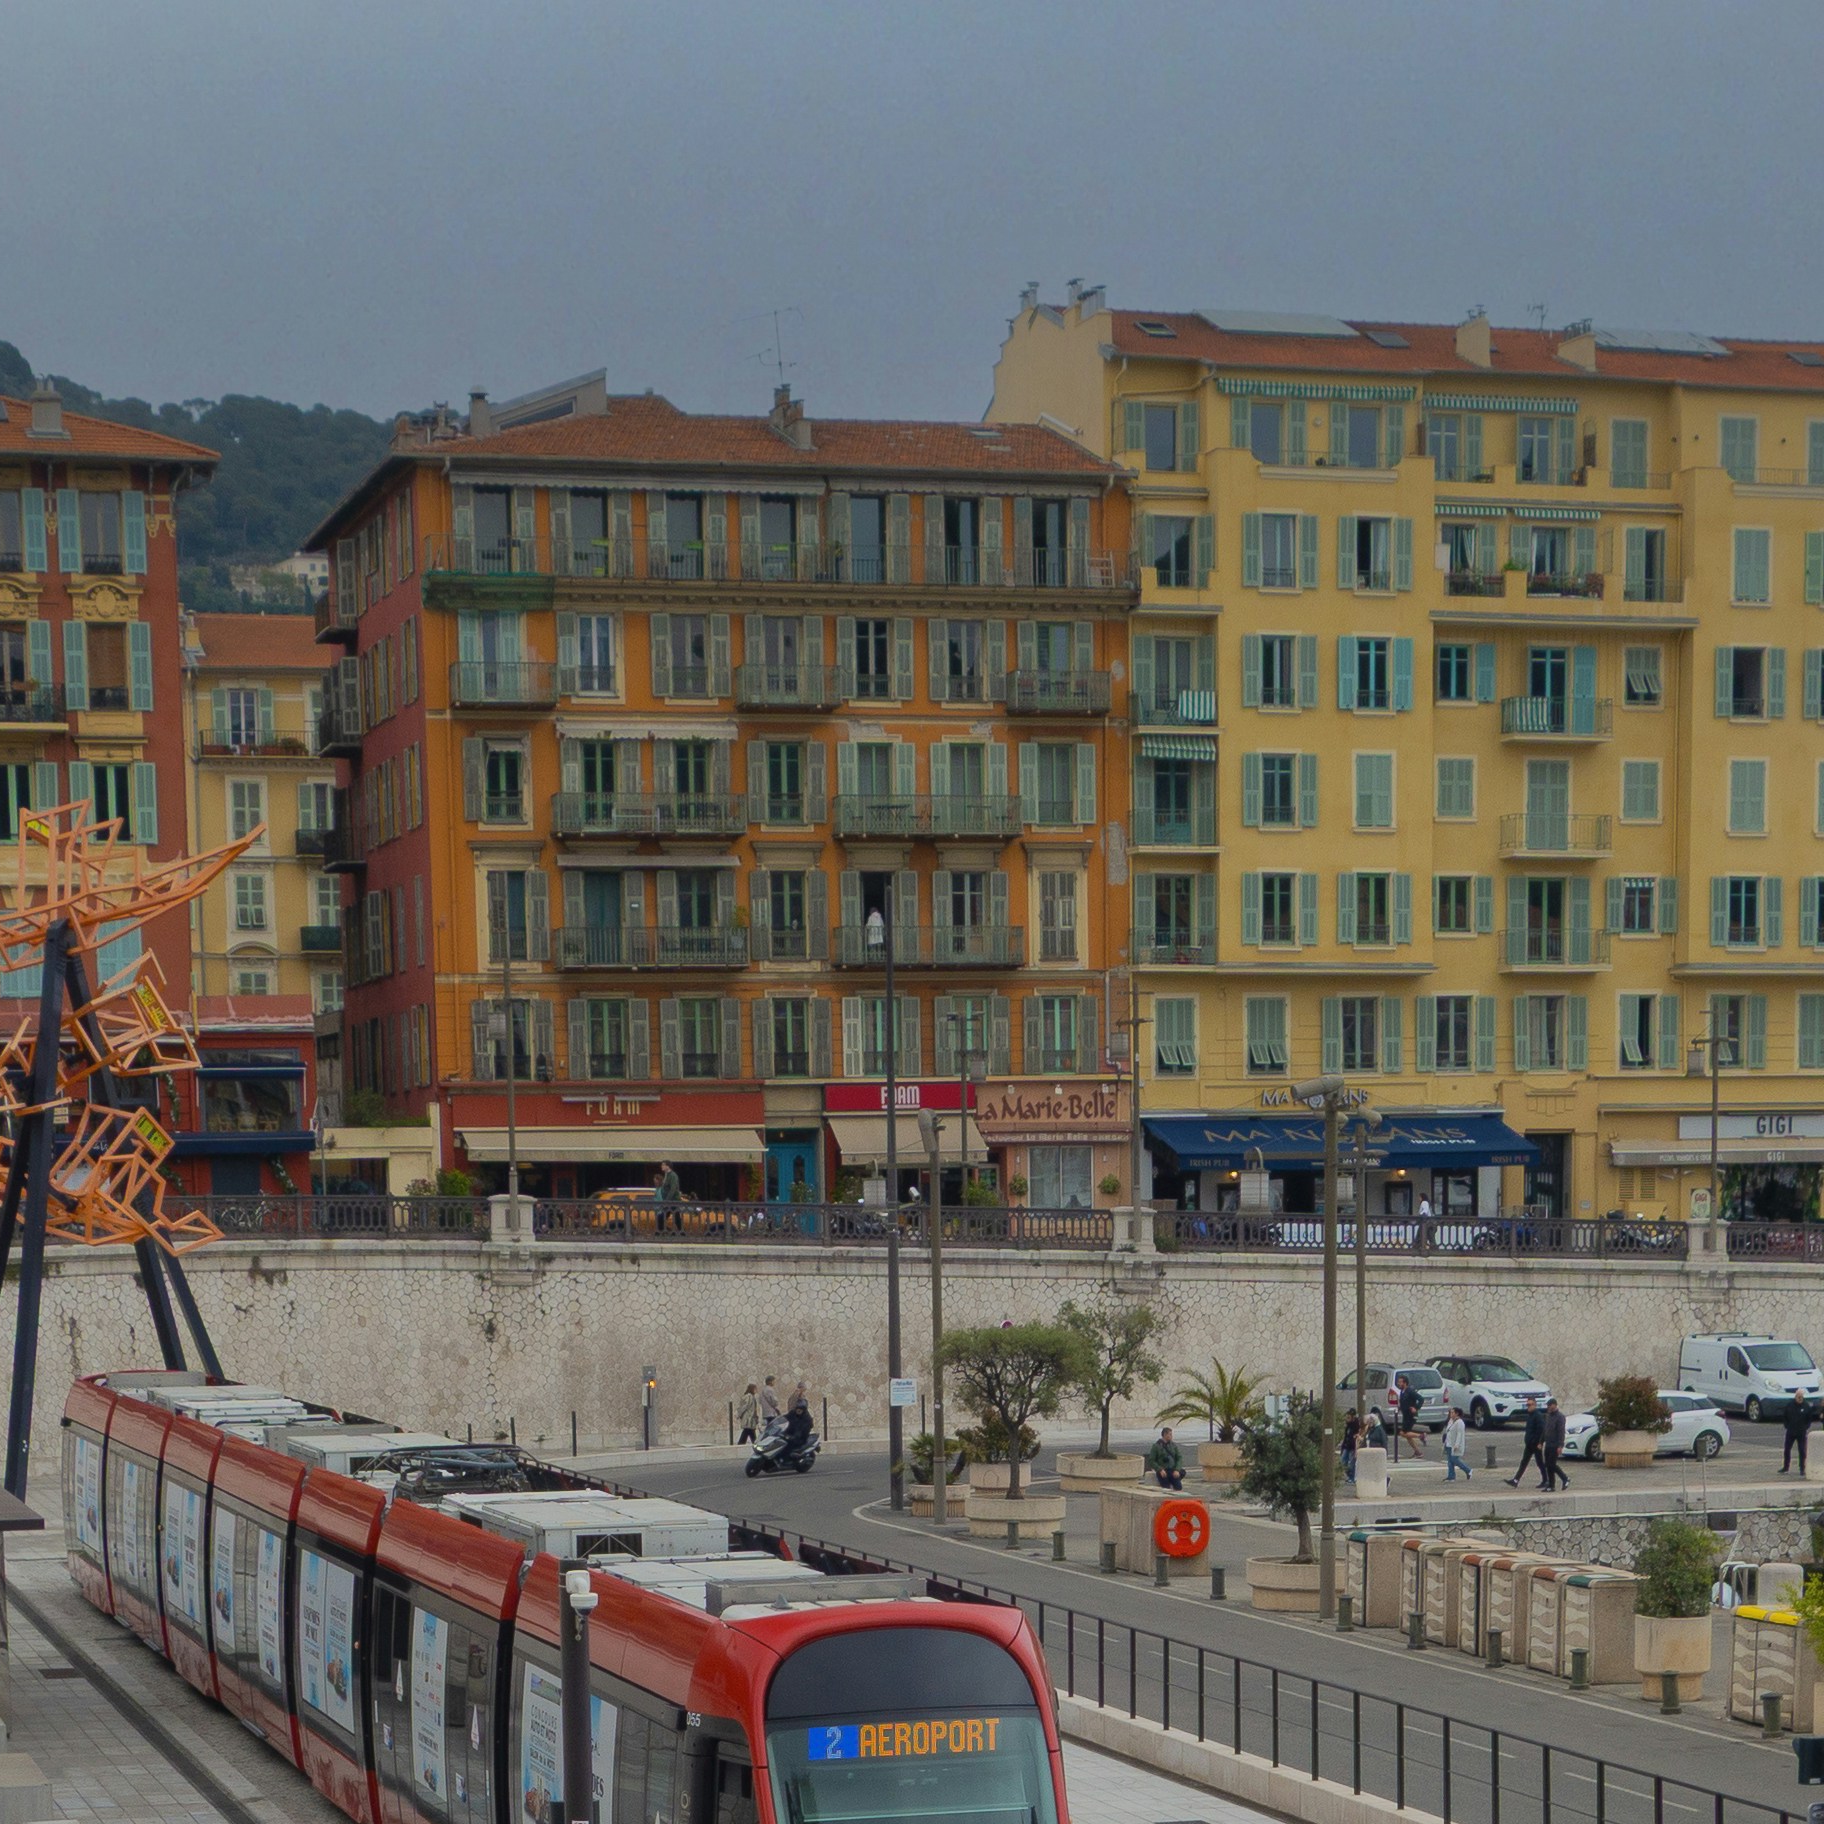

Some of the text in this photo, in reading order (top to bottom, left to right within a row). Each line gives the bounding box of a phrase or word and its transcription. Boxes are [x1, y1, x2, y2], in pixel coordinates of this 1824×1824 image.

[880, 1085, 920, 1104] FAM
[586, 1099, 640, 1115] FOAM
[1756, 1116, 1793, 1135] GIGI
[1190, 1159, 1230, 1167] IRISH PUB
[1491, 1155, 1530, 1164] IRISH PUB
[1767, 1152, 1785, 1161] GIGI
[1695, 1192, 1708, 1202] GIGI
[530, 1704, 558, 1730] CONCOURS
[825, 1718, 999, 1759] 2 AEROPORT
